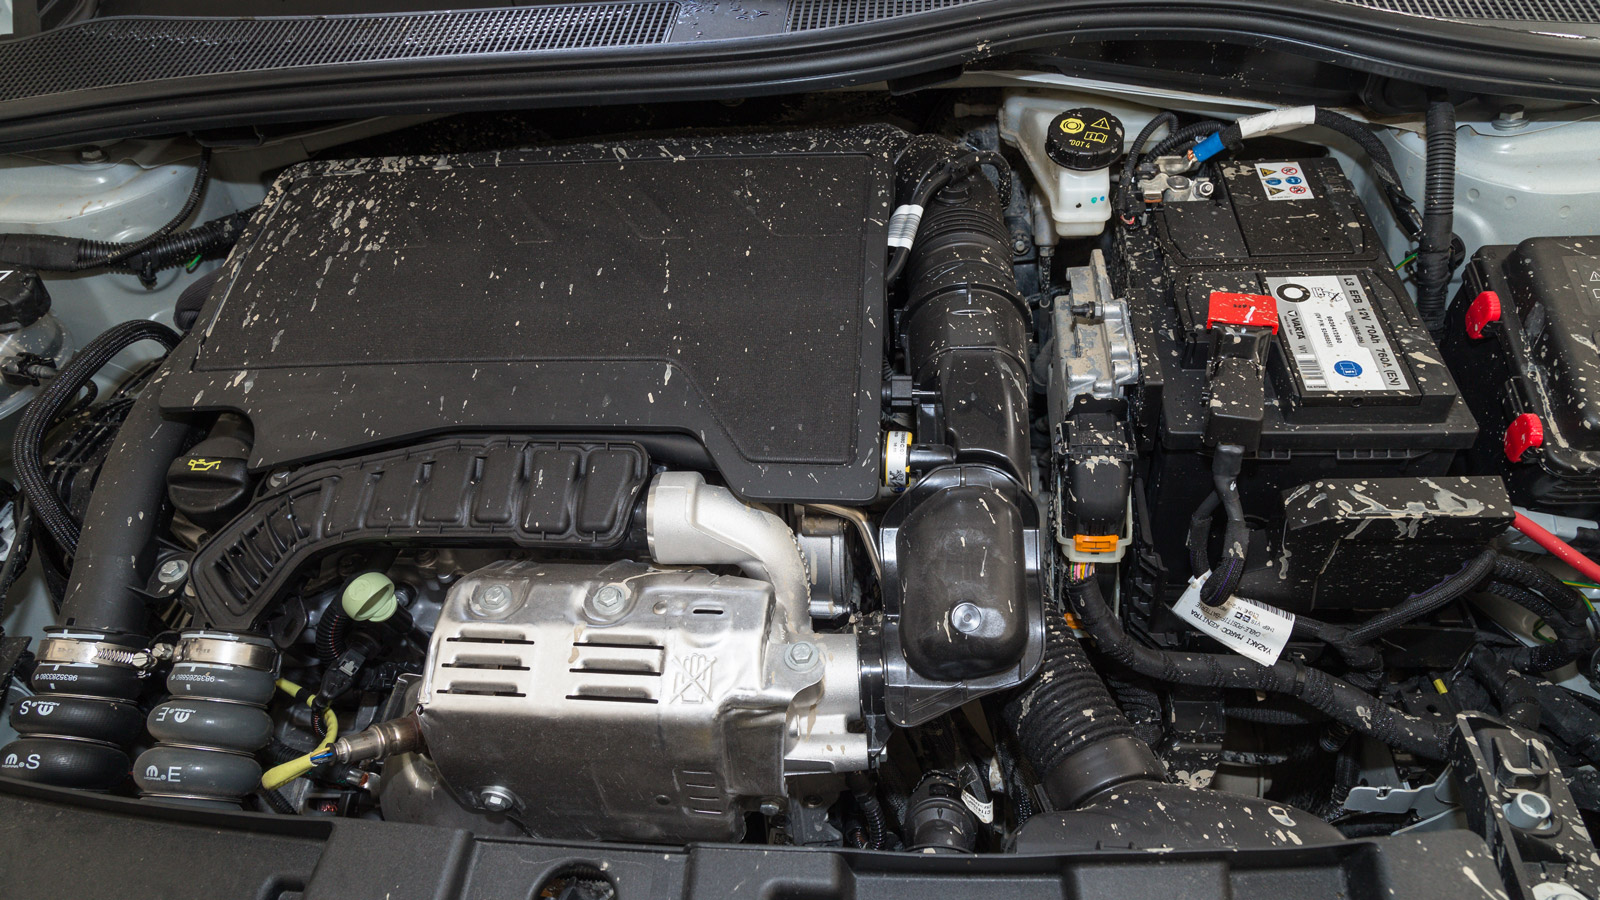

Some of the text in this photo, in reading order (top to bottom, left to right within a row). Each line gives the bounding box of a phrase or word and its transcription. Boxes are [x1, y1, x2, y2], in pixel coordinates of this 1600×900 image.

[1070, 140, 1085, 148] DOT
[1292, 318, 1305, 339] VARTA
[1343, 277, 1401, 386] L3 EFB 12V 70Ah 760A (EN)
[1190, 608, 1220, 630] KENITRA
[1221, 626, 1244, 640] MAROC
[1246, 638, 1272, 656] YAZAKI
[20, 700, 32, 715] S
[156, 706, 170, 722] E
[26, 754, 41, 770] S
[168, 766, 182, 782] E
